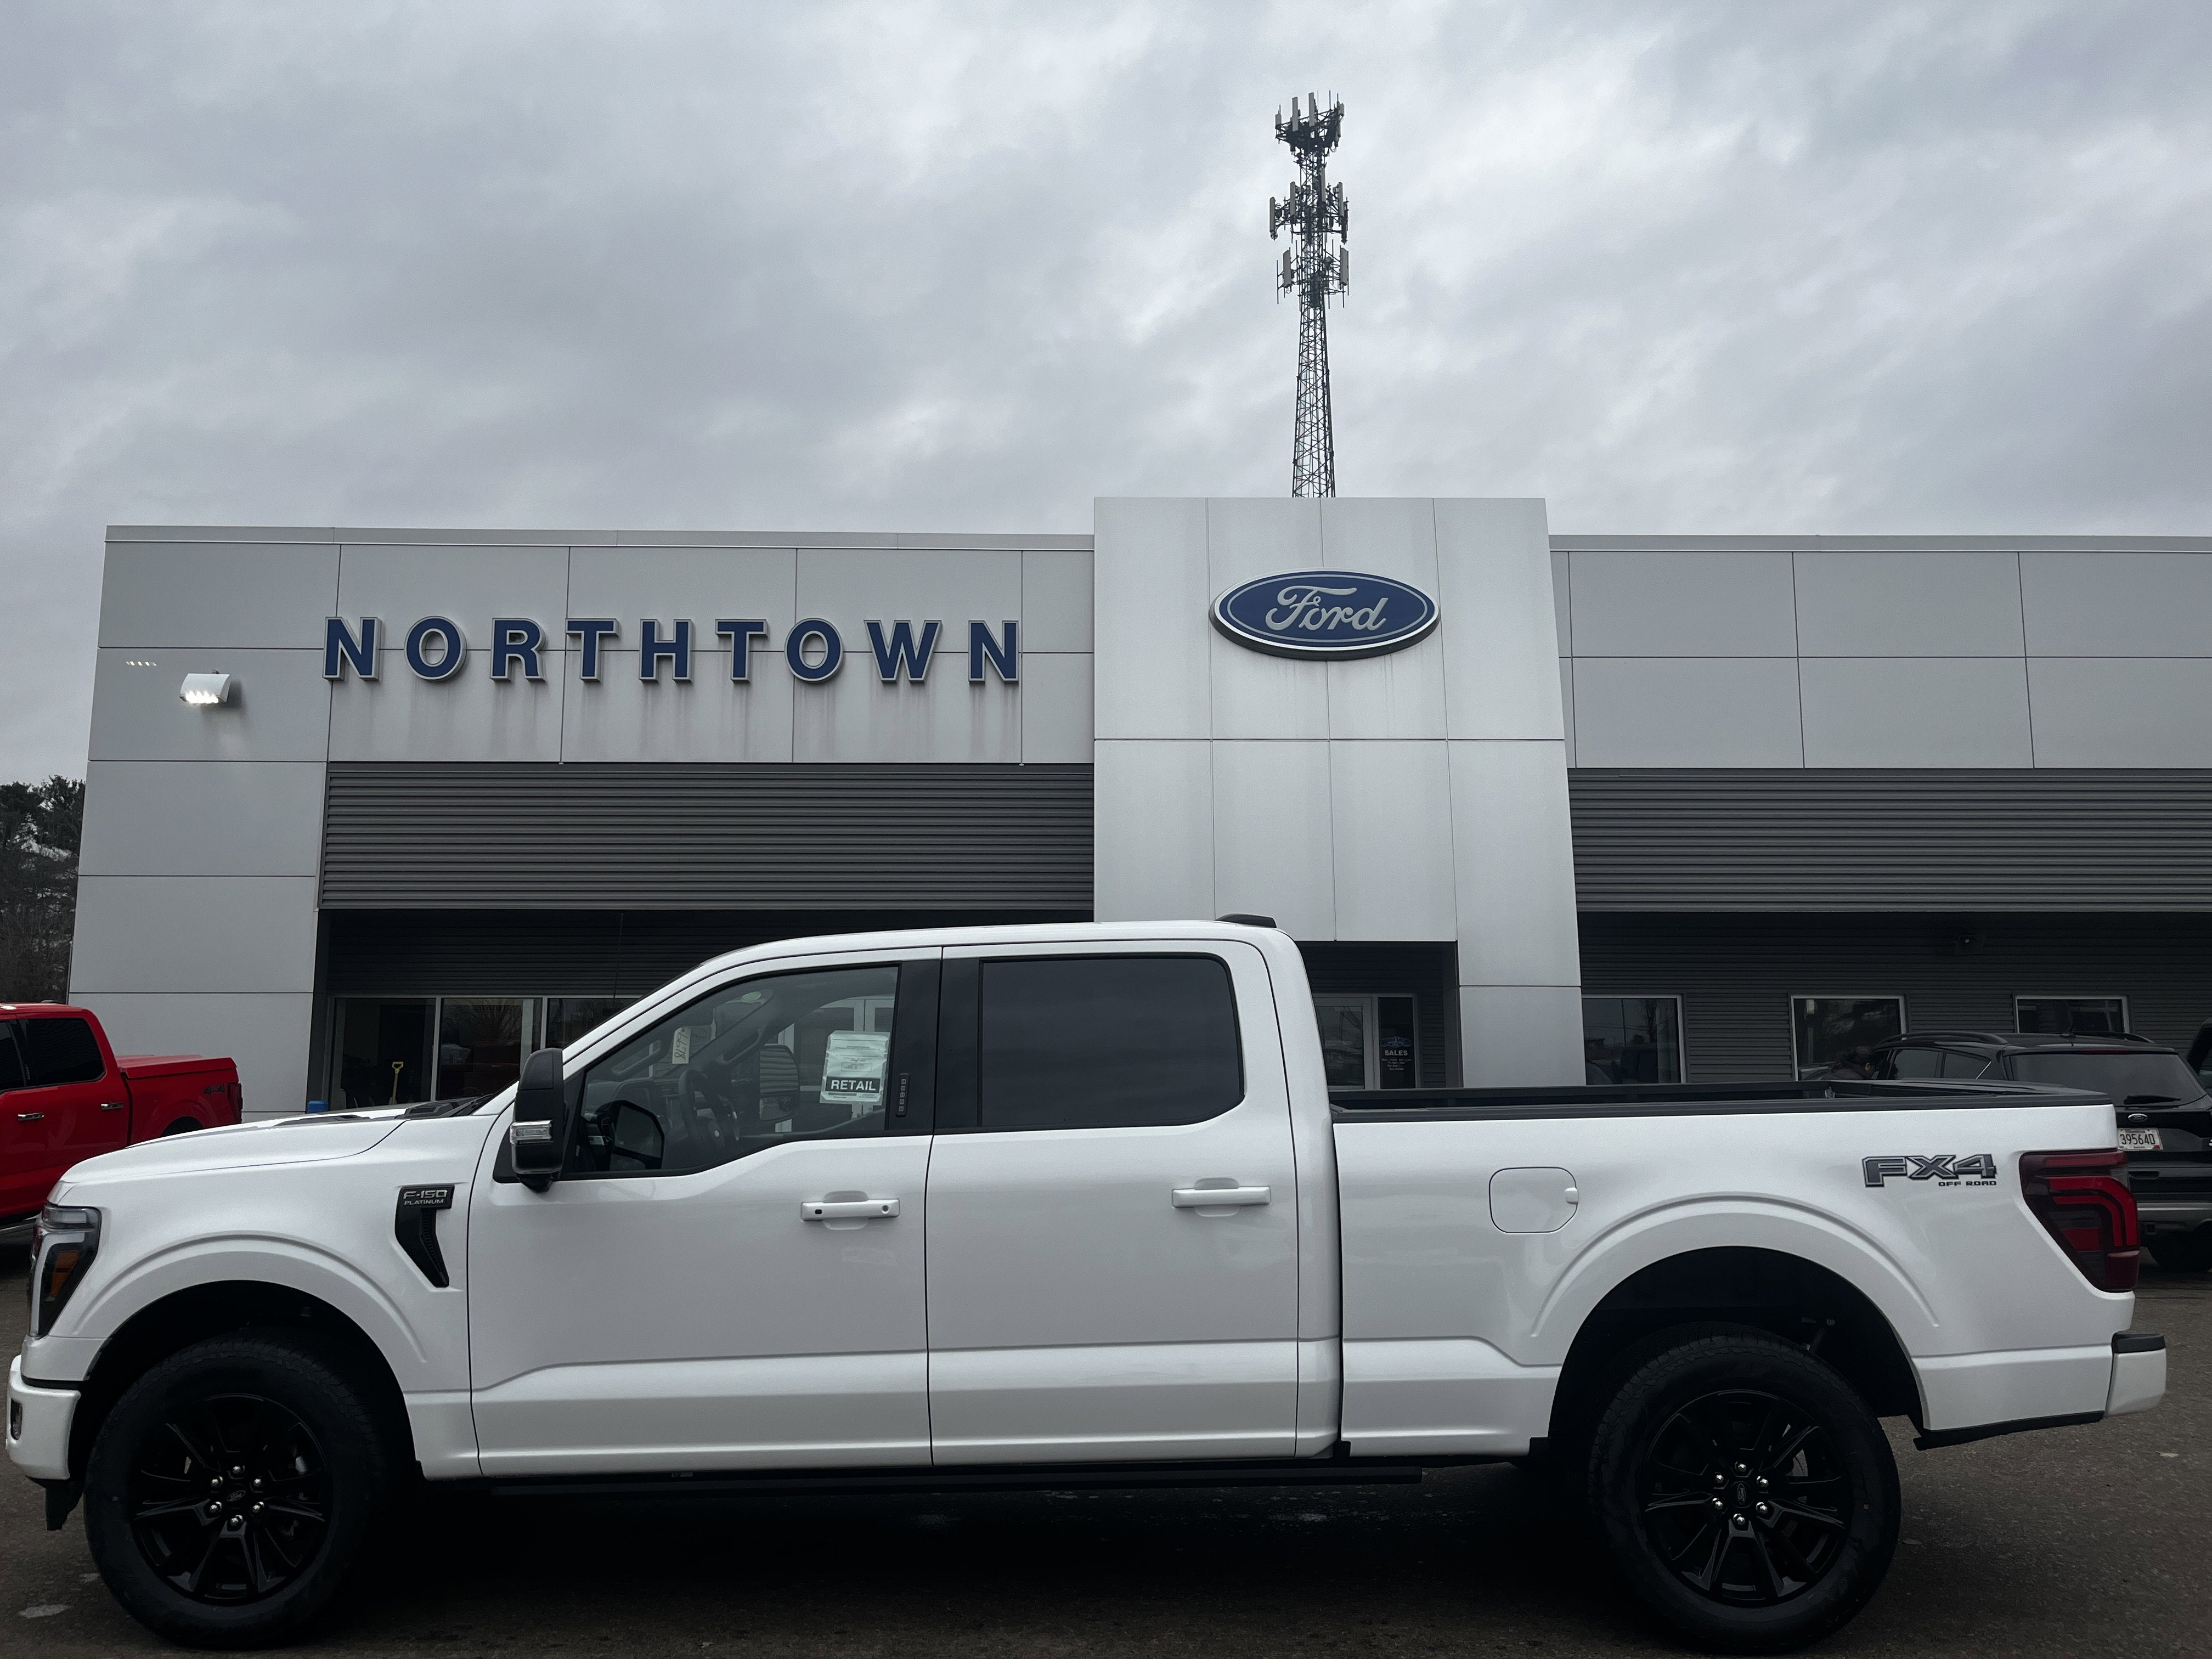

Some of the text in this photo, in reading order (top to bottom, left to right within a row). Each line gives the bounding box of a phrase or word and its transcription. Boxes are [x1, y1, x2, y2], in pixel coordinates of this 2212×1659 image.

[1265, 585, 1389, 631] Ford
[322, 615, 1019, 684] NORTHTOWN
[831, 1080, 876, 1091] RETAIL
[1862, 1154, 1997, 1187] FX4
[403, 1189, 448, 1199] F-150
